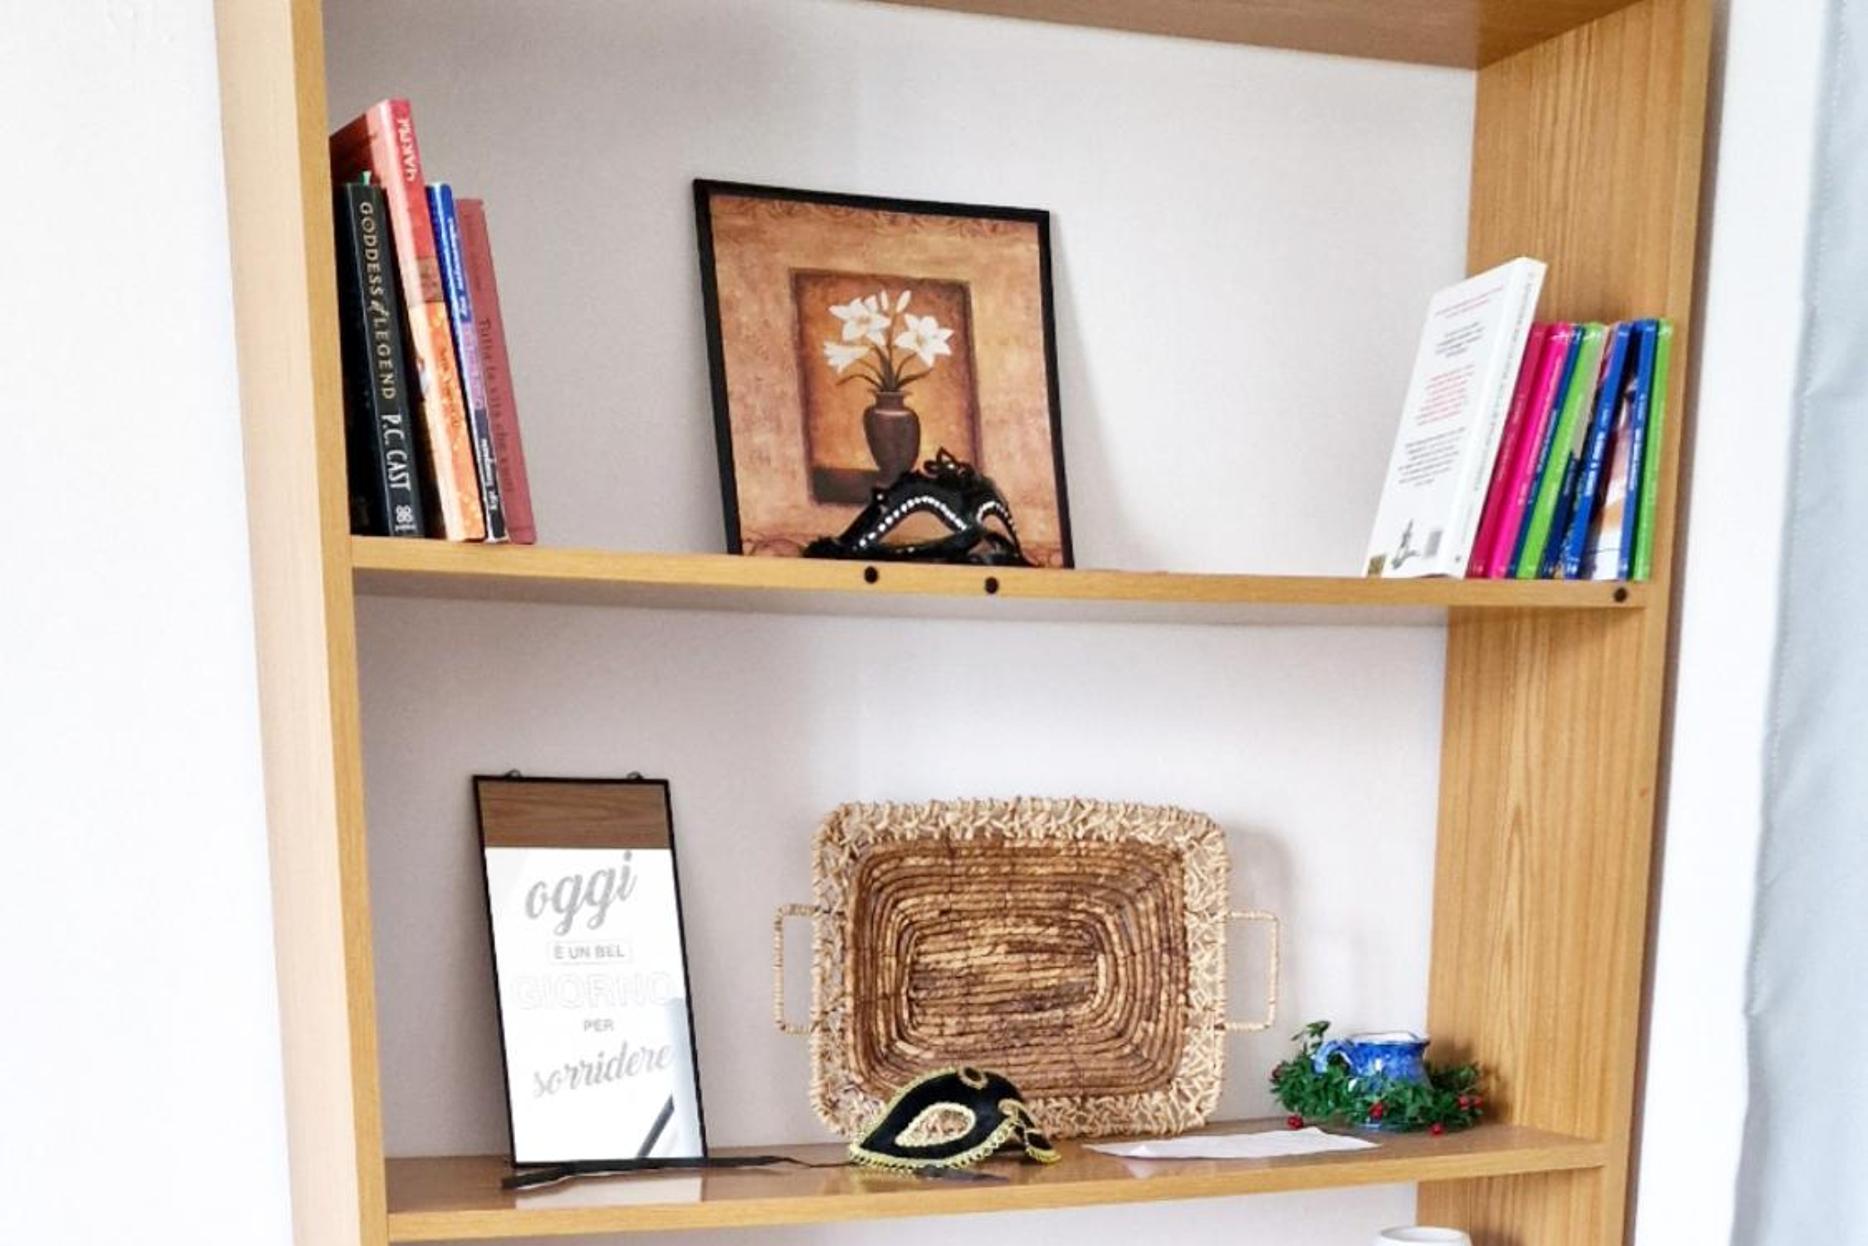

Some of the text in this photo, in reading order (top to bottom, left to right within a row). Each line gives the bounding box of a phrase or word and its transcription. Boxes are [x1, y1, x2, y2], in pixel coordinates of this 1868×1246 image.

[359, 201, 385, 297] GODDESS
[373, 317, 397, 400] LEGEND
[381, 413, 405, 446] P.C.
[386, 449, 411, 491] CAST
[524, 850, 638, 937] oggi
[568, 944, 592, 960] UN
[595, 943, 626, 959] BEL
[512, 972, 674, 1010] GIORNO
[582, 1018, 616, 1033] PER
[532, 1038, 673, 1099] sorridere
